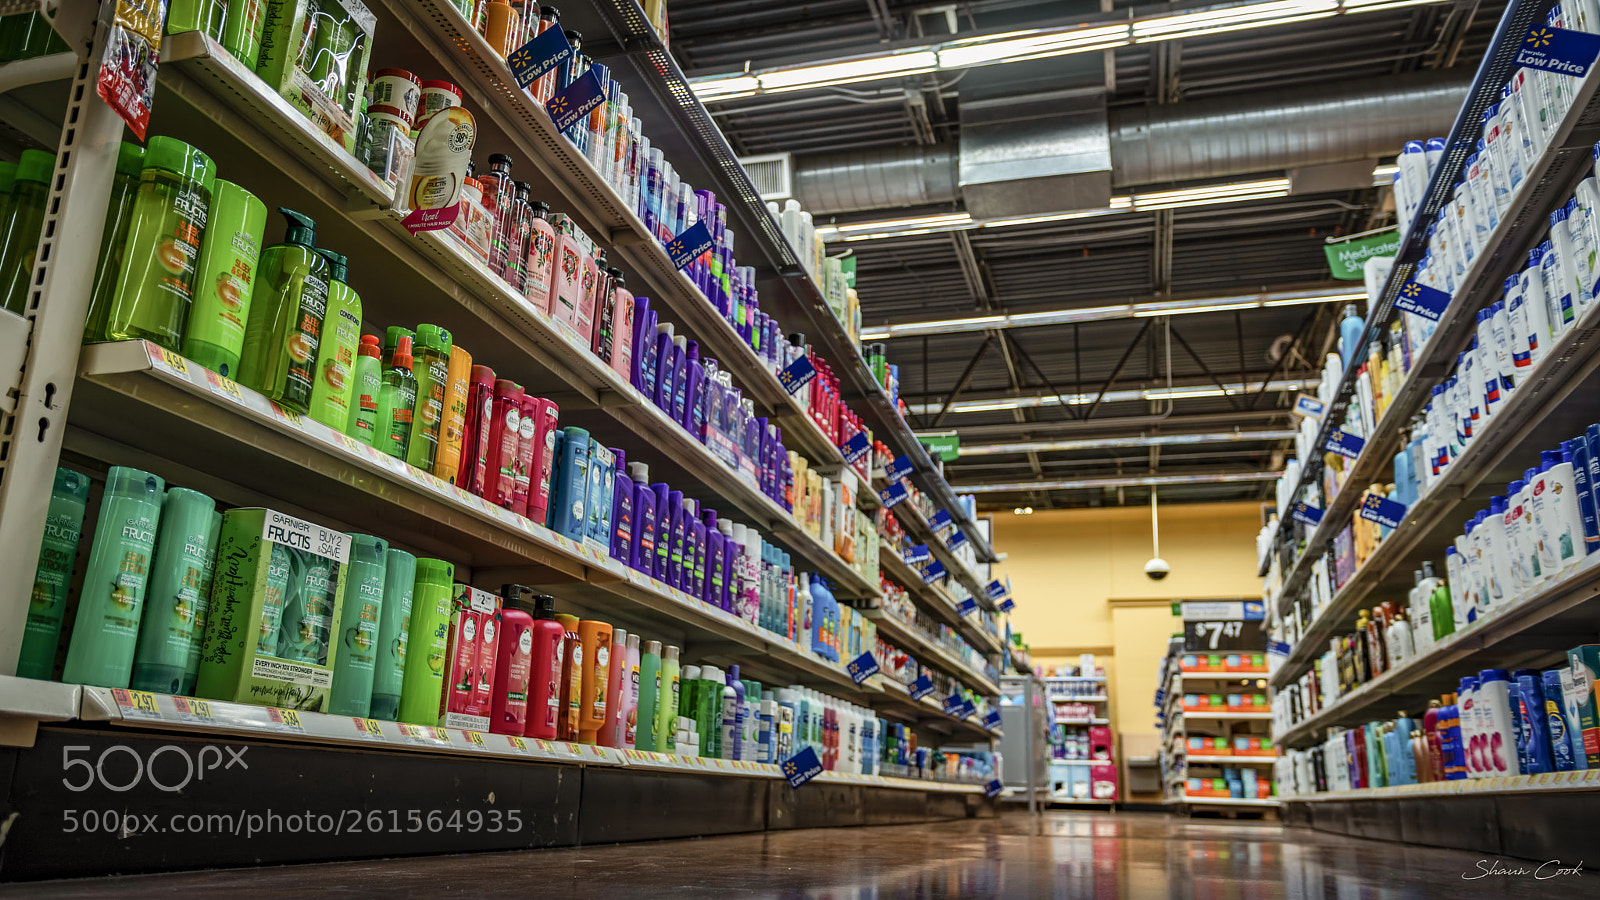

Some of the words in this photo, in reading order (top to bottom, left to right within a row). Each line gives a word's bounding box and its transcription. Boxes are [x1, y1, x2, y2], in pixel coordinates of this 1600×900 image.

[1522, 49, 1546, 57] Everyday
[519, 64, 537, 77] Everyday
[520, 67, 542, 84] Low
[542, 49, 569, 70] Price
[1516, 53, 1548, 67] Low
[1546, 59, 1584, 73] Price
[558, 112, 578, 130] Low
[578, 94, 602, 115] Price
[174, 197, 207, 223] FRUCTIS
[231, 237, 257, 260] FRUCTIS
[676, 254, 692, 268] Low
[692, 241, 712, 257] Price
[301, 293, 325, 314] FRUCTIS
[1396, 298, 1416, 311] Low
[1416, 305, 1438, 319] Price
[272, 514, 310, 532] GARNIER
[1362, 508, 1378, 520] Low
[1378, 516, 1398, 527] Price
[268, 524, 311, 550] FRUCTIS
[319, 530, 336, 544] BUY
[336, 537, 342, 547] 2
[43, 548, 69, 561] GROW
[125, 551, 146, 565] GROW
[321, 543, 340, 559] SAVE
[225, 546, 248, 587] Hair
[269, 565, 289, 580] RUCTIS
[481, 594, 485, 605] 2
[290, 666, 313, 674] STRONGER
[791, 775, 805, 788] Low
[804, 765, 821, 779] Price
